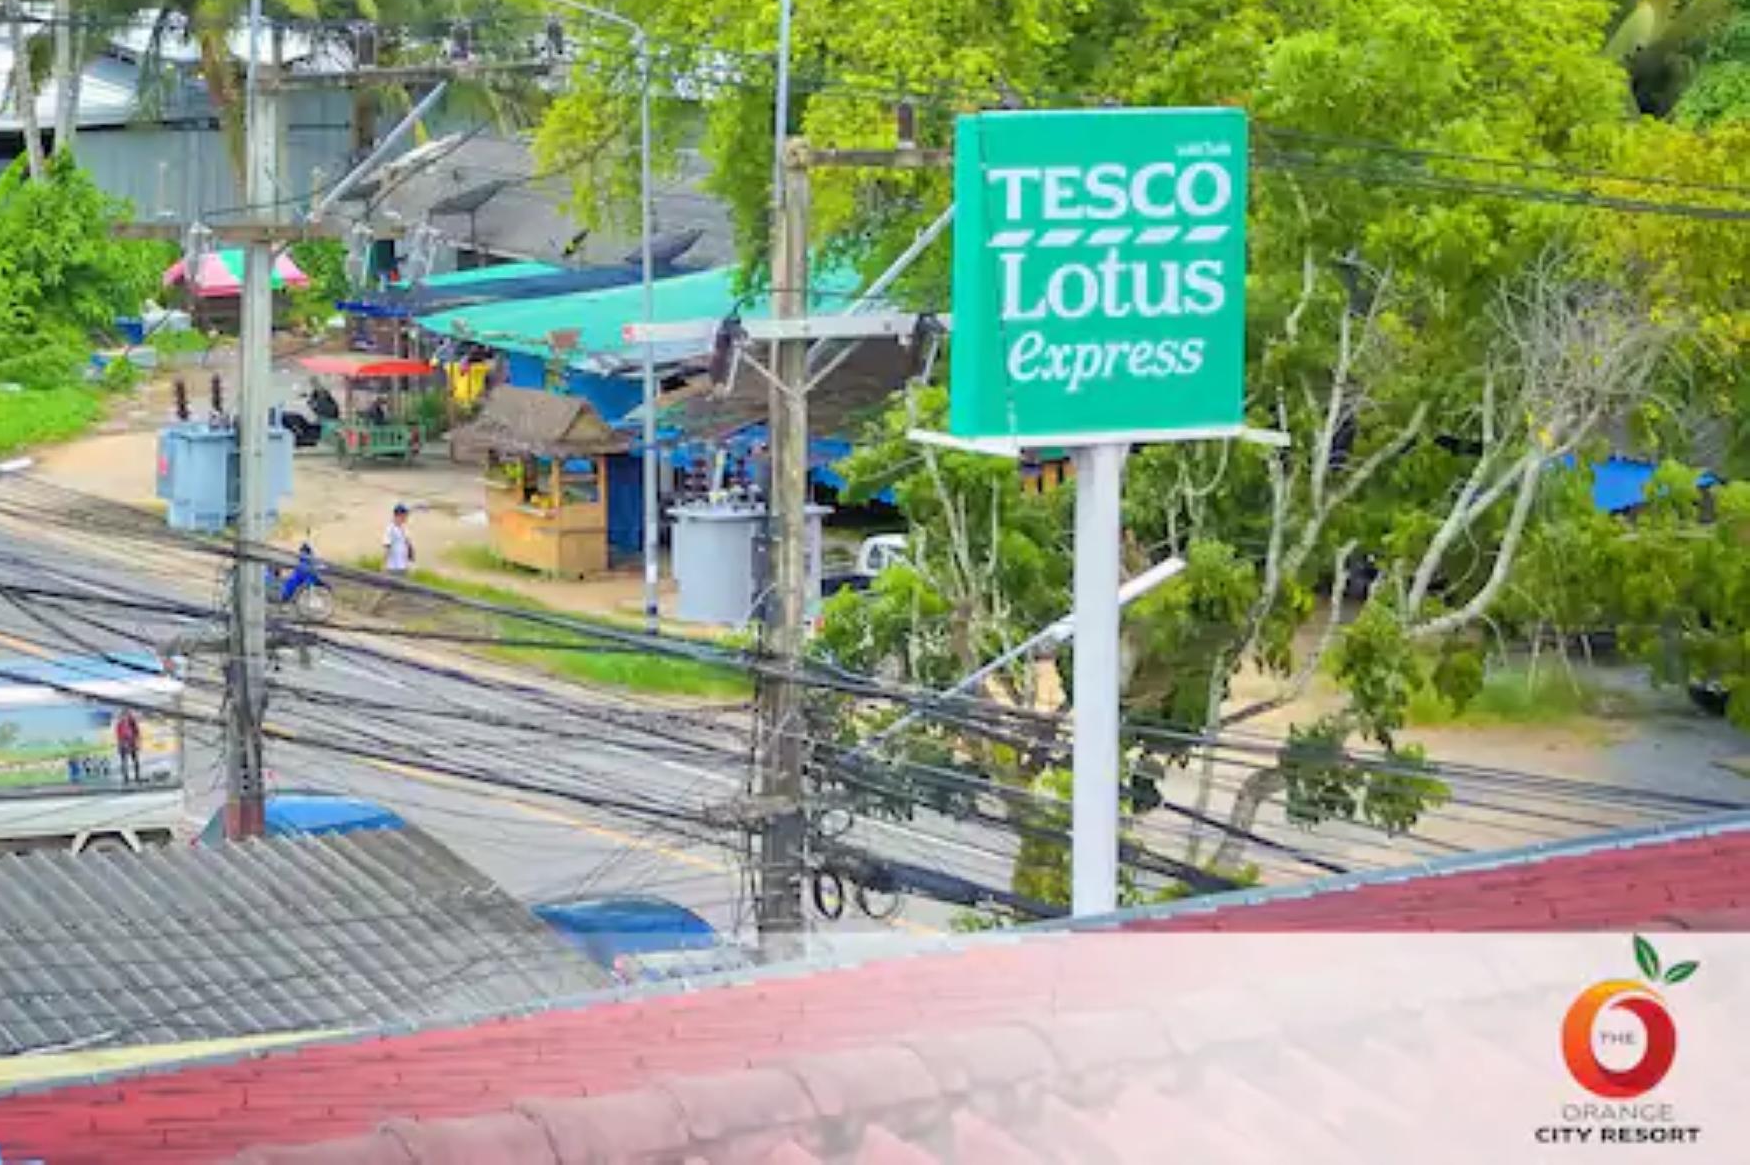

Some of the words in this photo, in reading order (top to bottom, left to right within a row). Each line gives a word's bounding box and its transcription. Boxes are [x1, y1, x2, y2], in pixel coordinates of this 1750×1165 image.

[987, 162, 1232, 220] TESCO
[1000, 246, 1226, 321] Lotus
[1007, 330, 1206, 393] express
